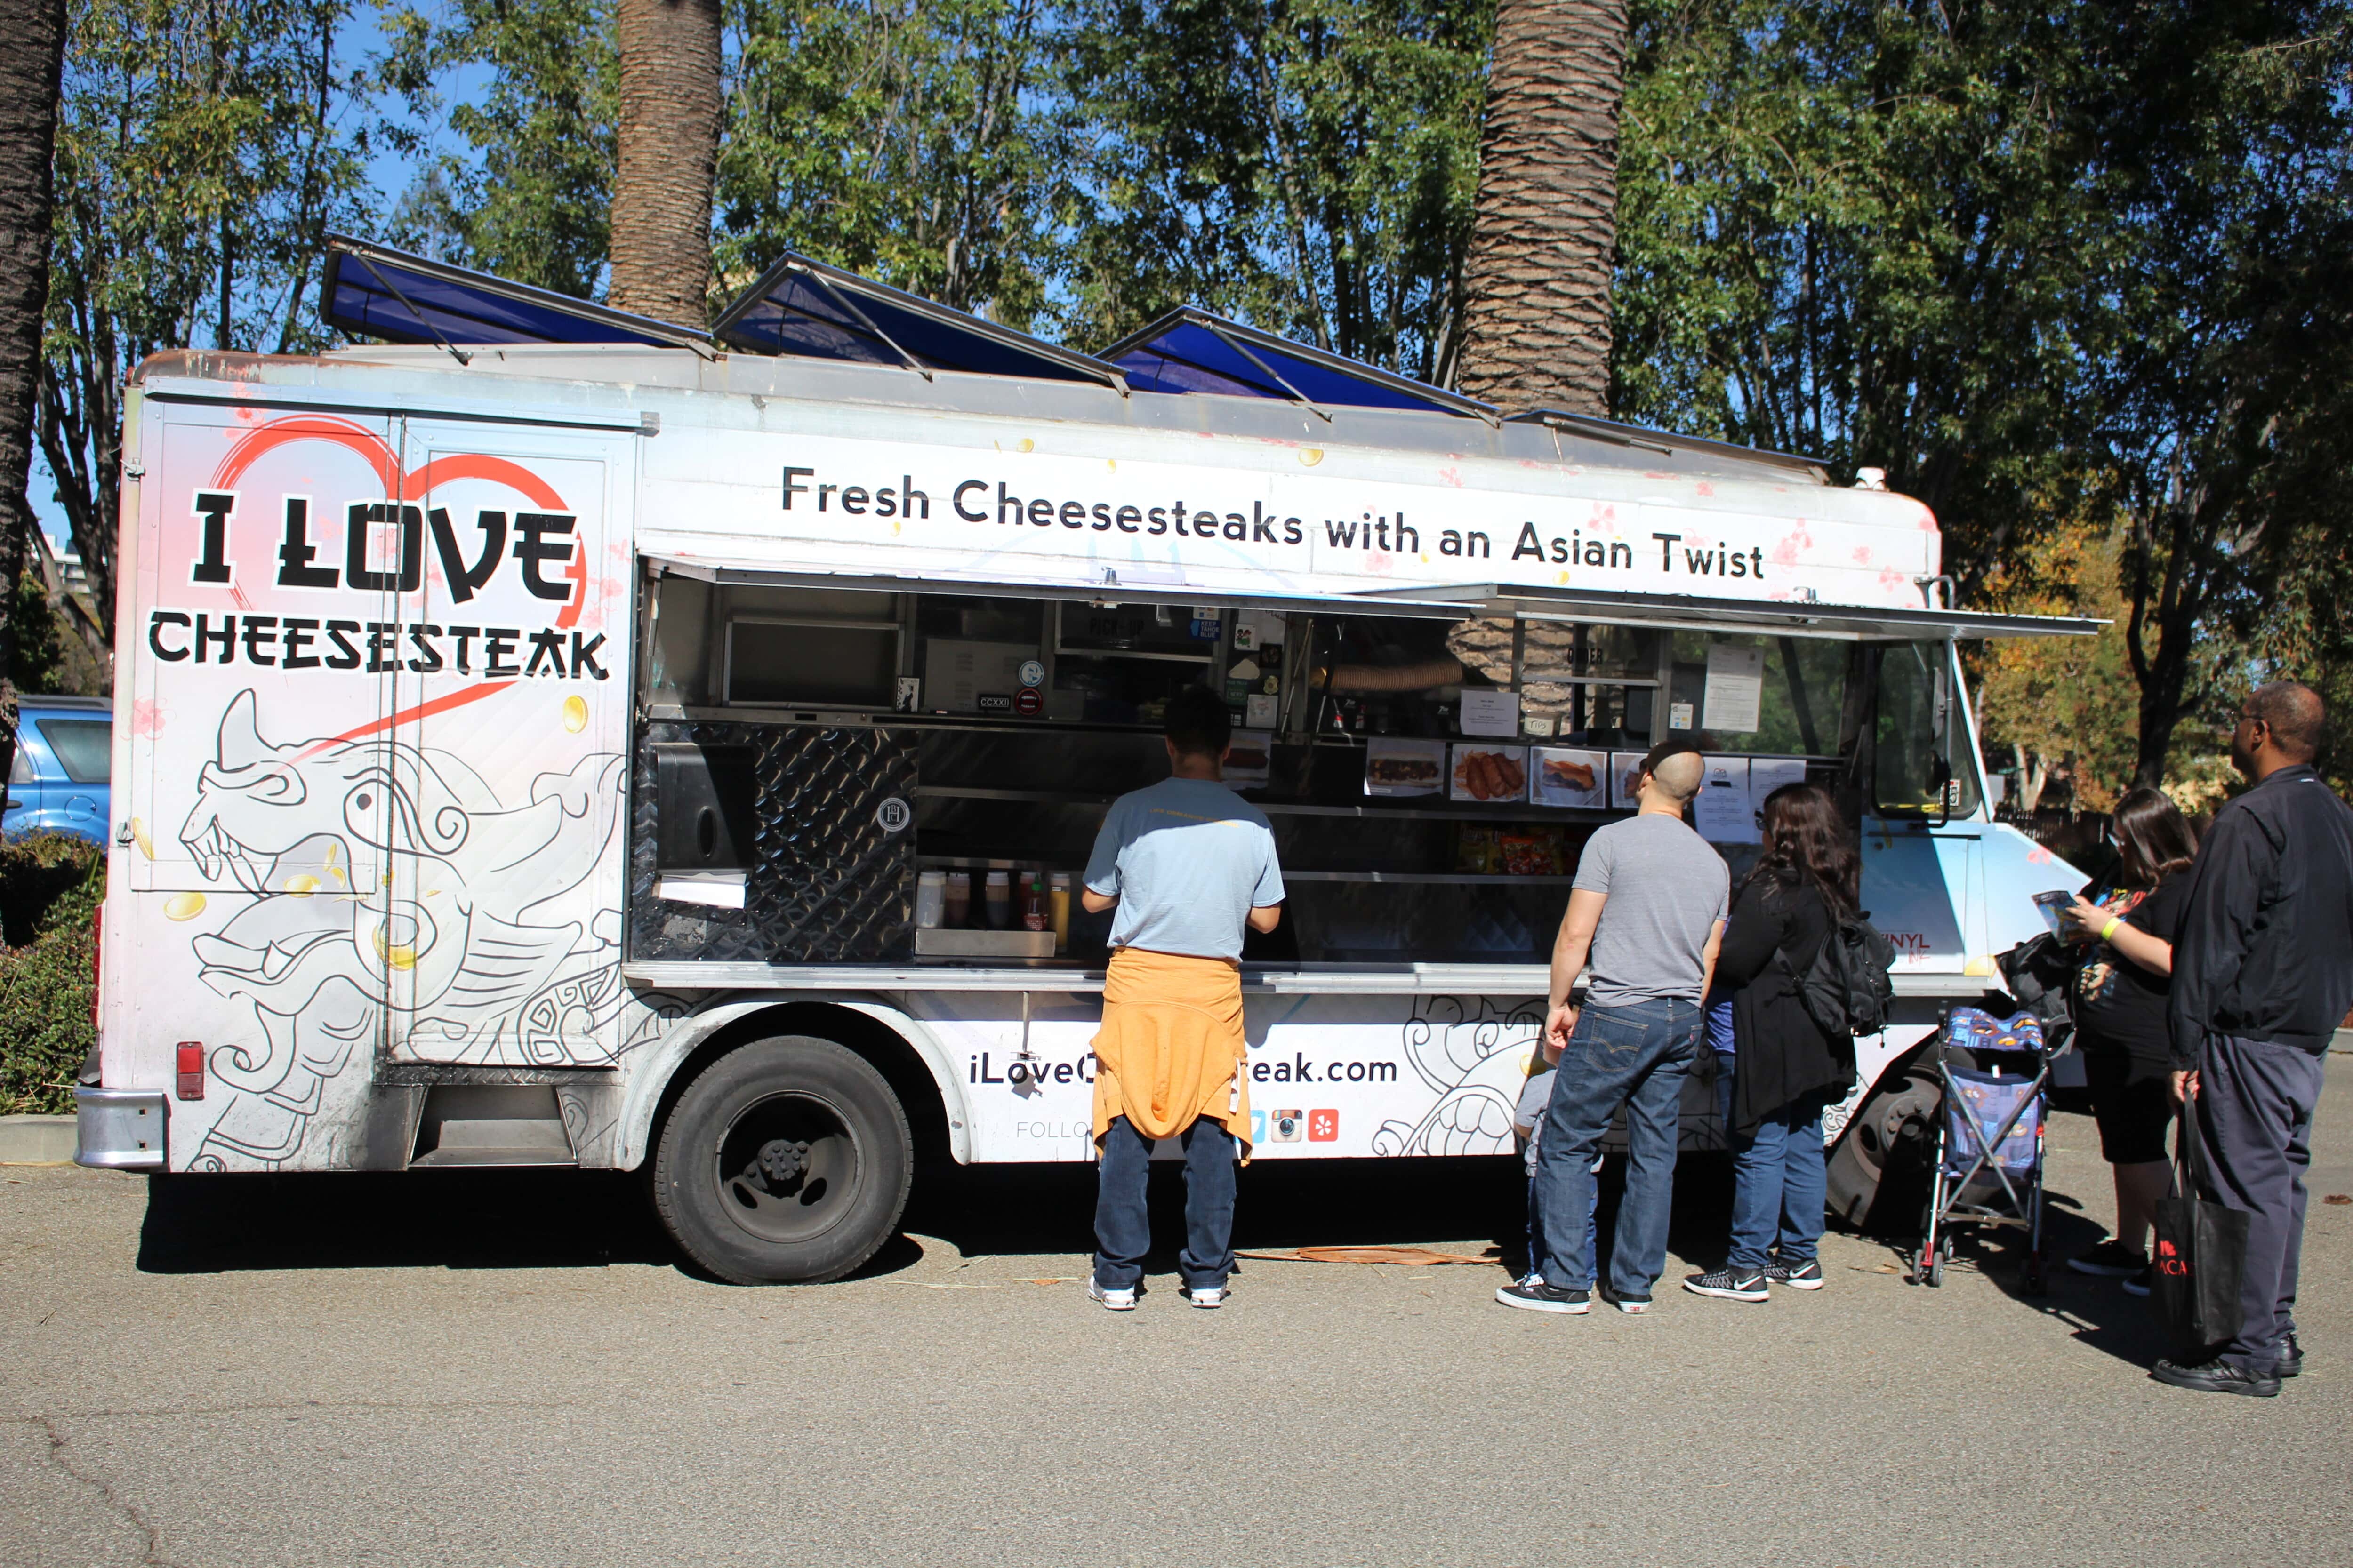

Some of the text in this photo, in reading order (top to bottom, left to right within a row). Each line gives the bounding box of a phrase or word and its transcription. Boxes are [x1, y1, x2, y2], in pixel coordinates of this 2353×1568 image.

[781, 466, 1764, 579] Fresh Cheesesteaks with an Asian Twist
[192, 494, 577, 604] I LOVE
[149, 611, 609, 680] CHEESESTEAK
[1568, 648, 1602, 664] ODER
[1882, 934, 1930, 948] NYL
[1017, 1121, 1093, 1138] FOLLO
